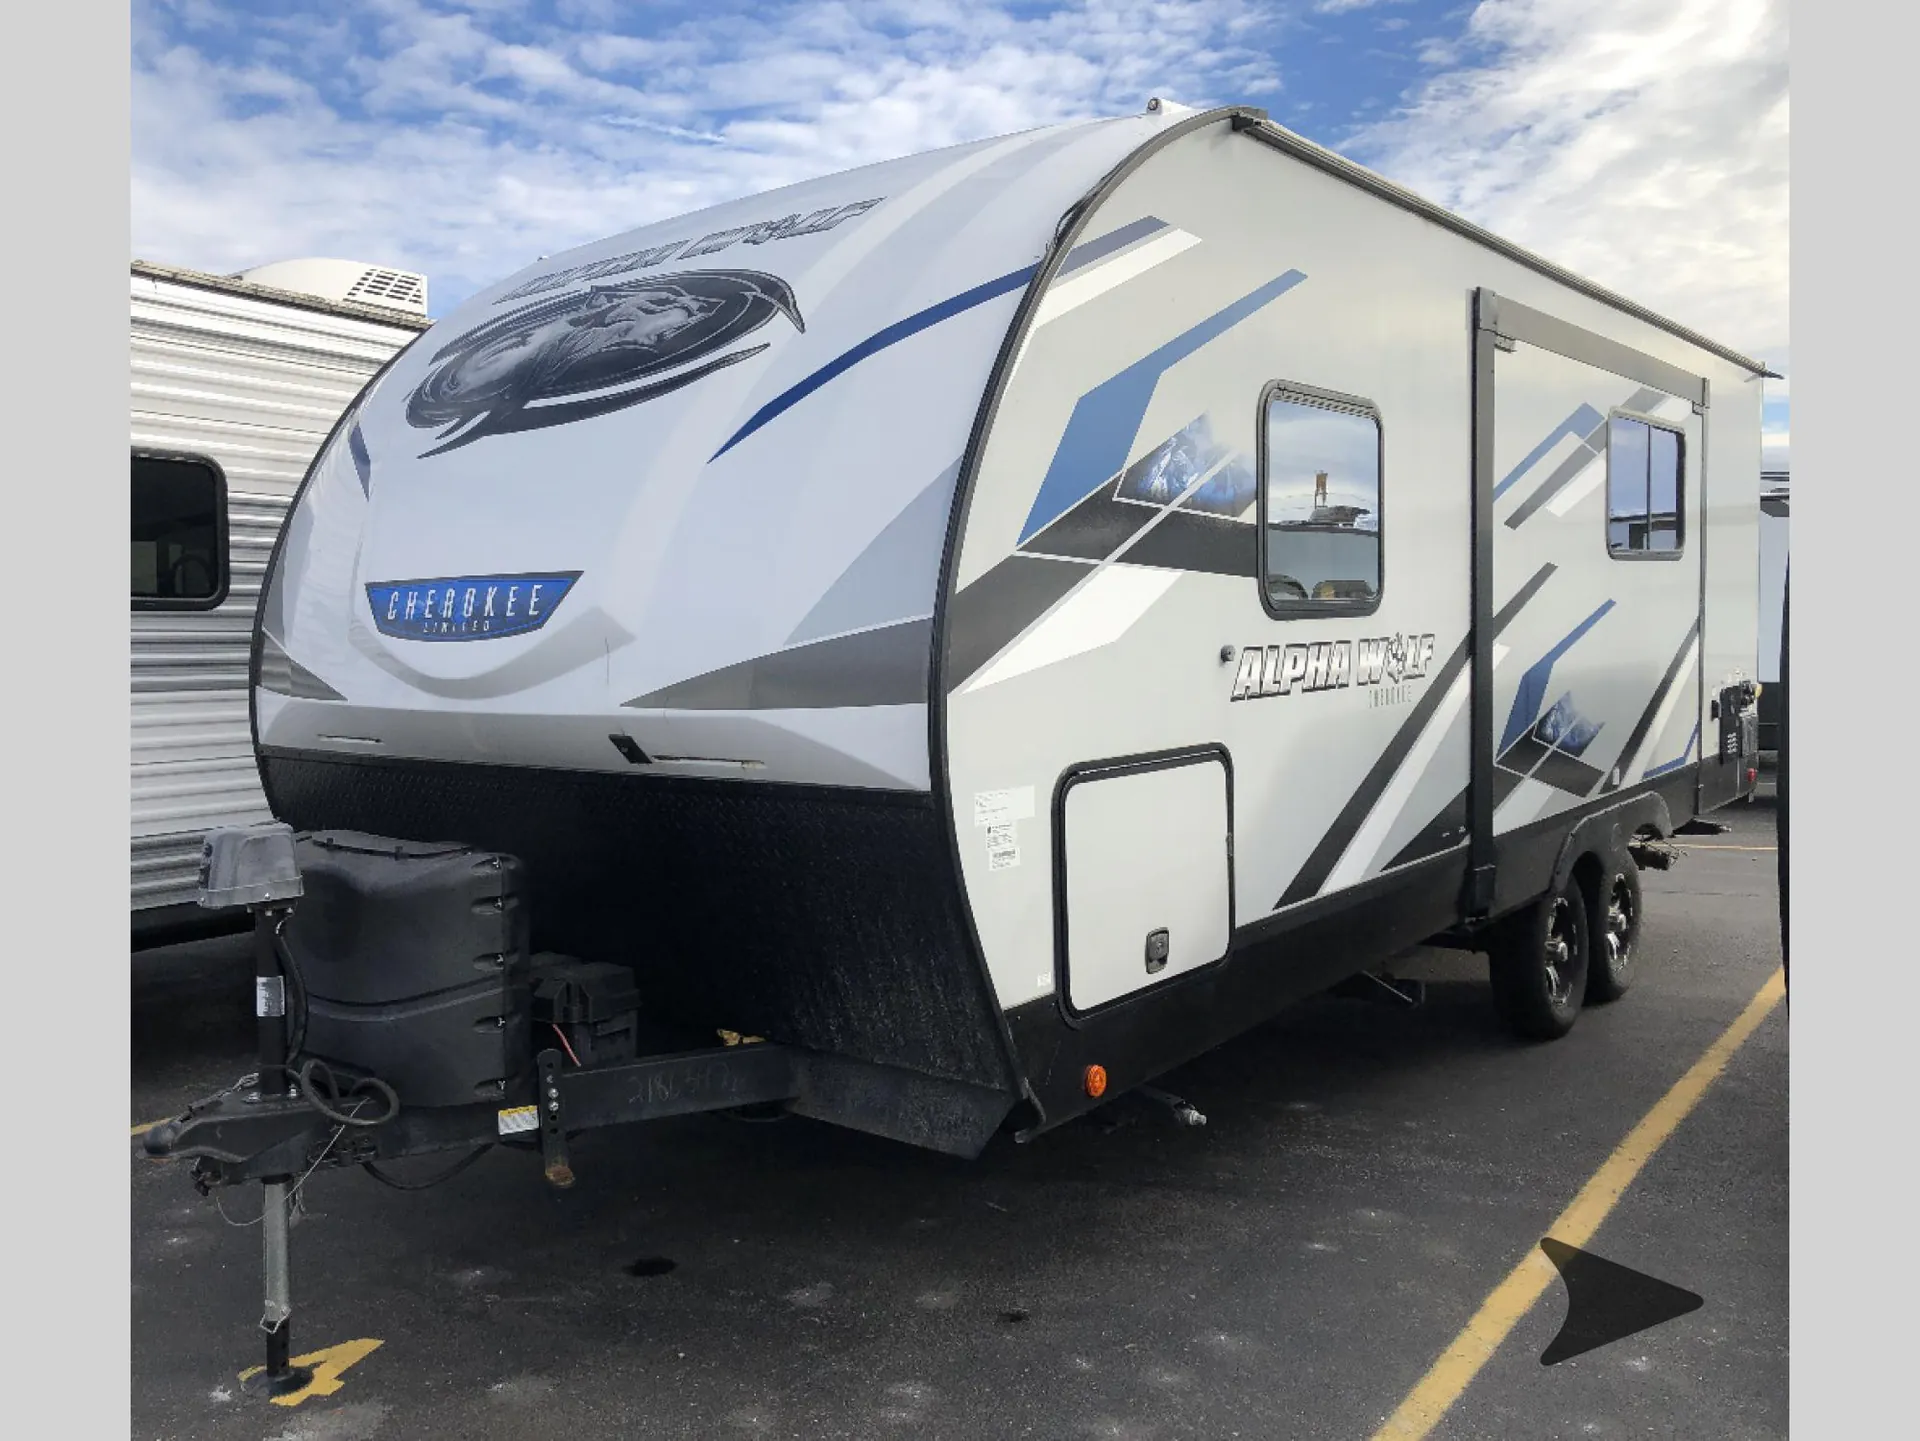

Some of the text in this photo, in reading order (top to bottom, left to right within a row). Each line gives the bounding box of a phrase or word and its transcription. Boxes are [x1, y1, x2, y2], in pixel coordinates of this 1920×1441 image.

[387, 584, 543, 620] CHEROKEE
[422, 620, 490, 633] LIMITED
[1230, 640, 1352, 702] ALPHA
